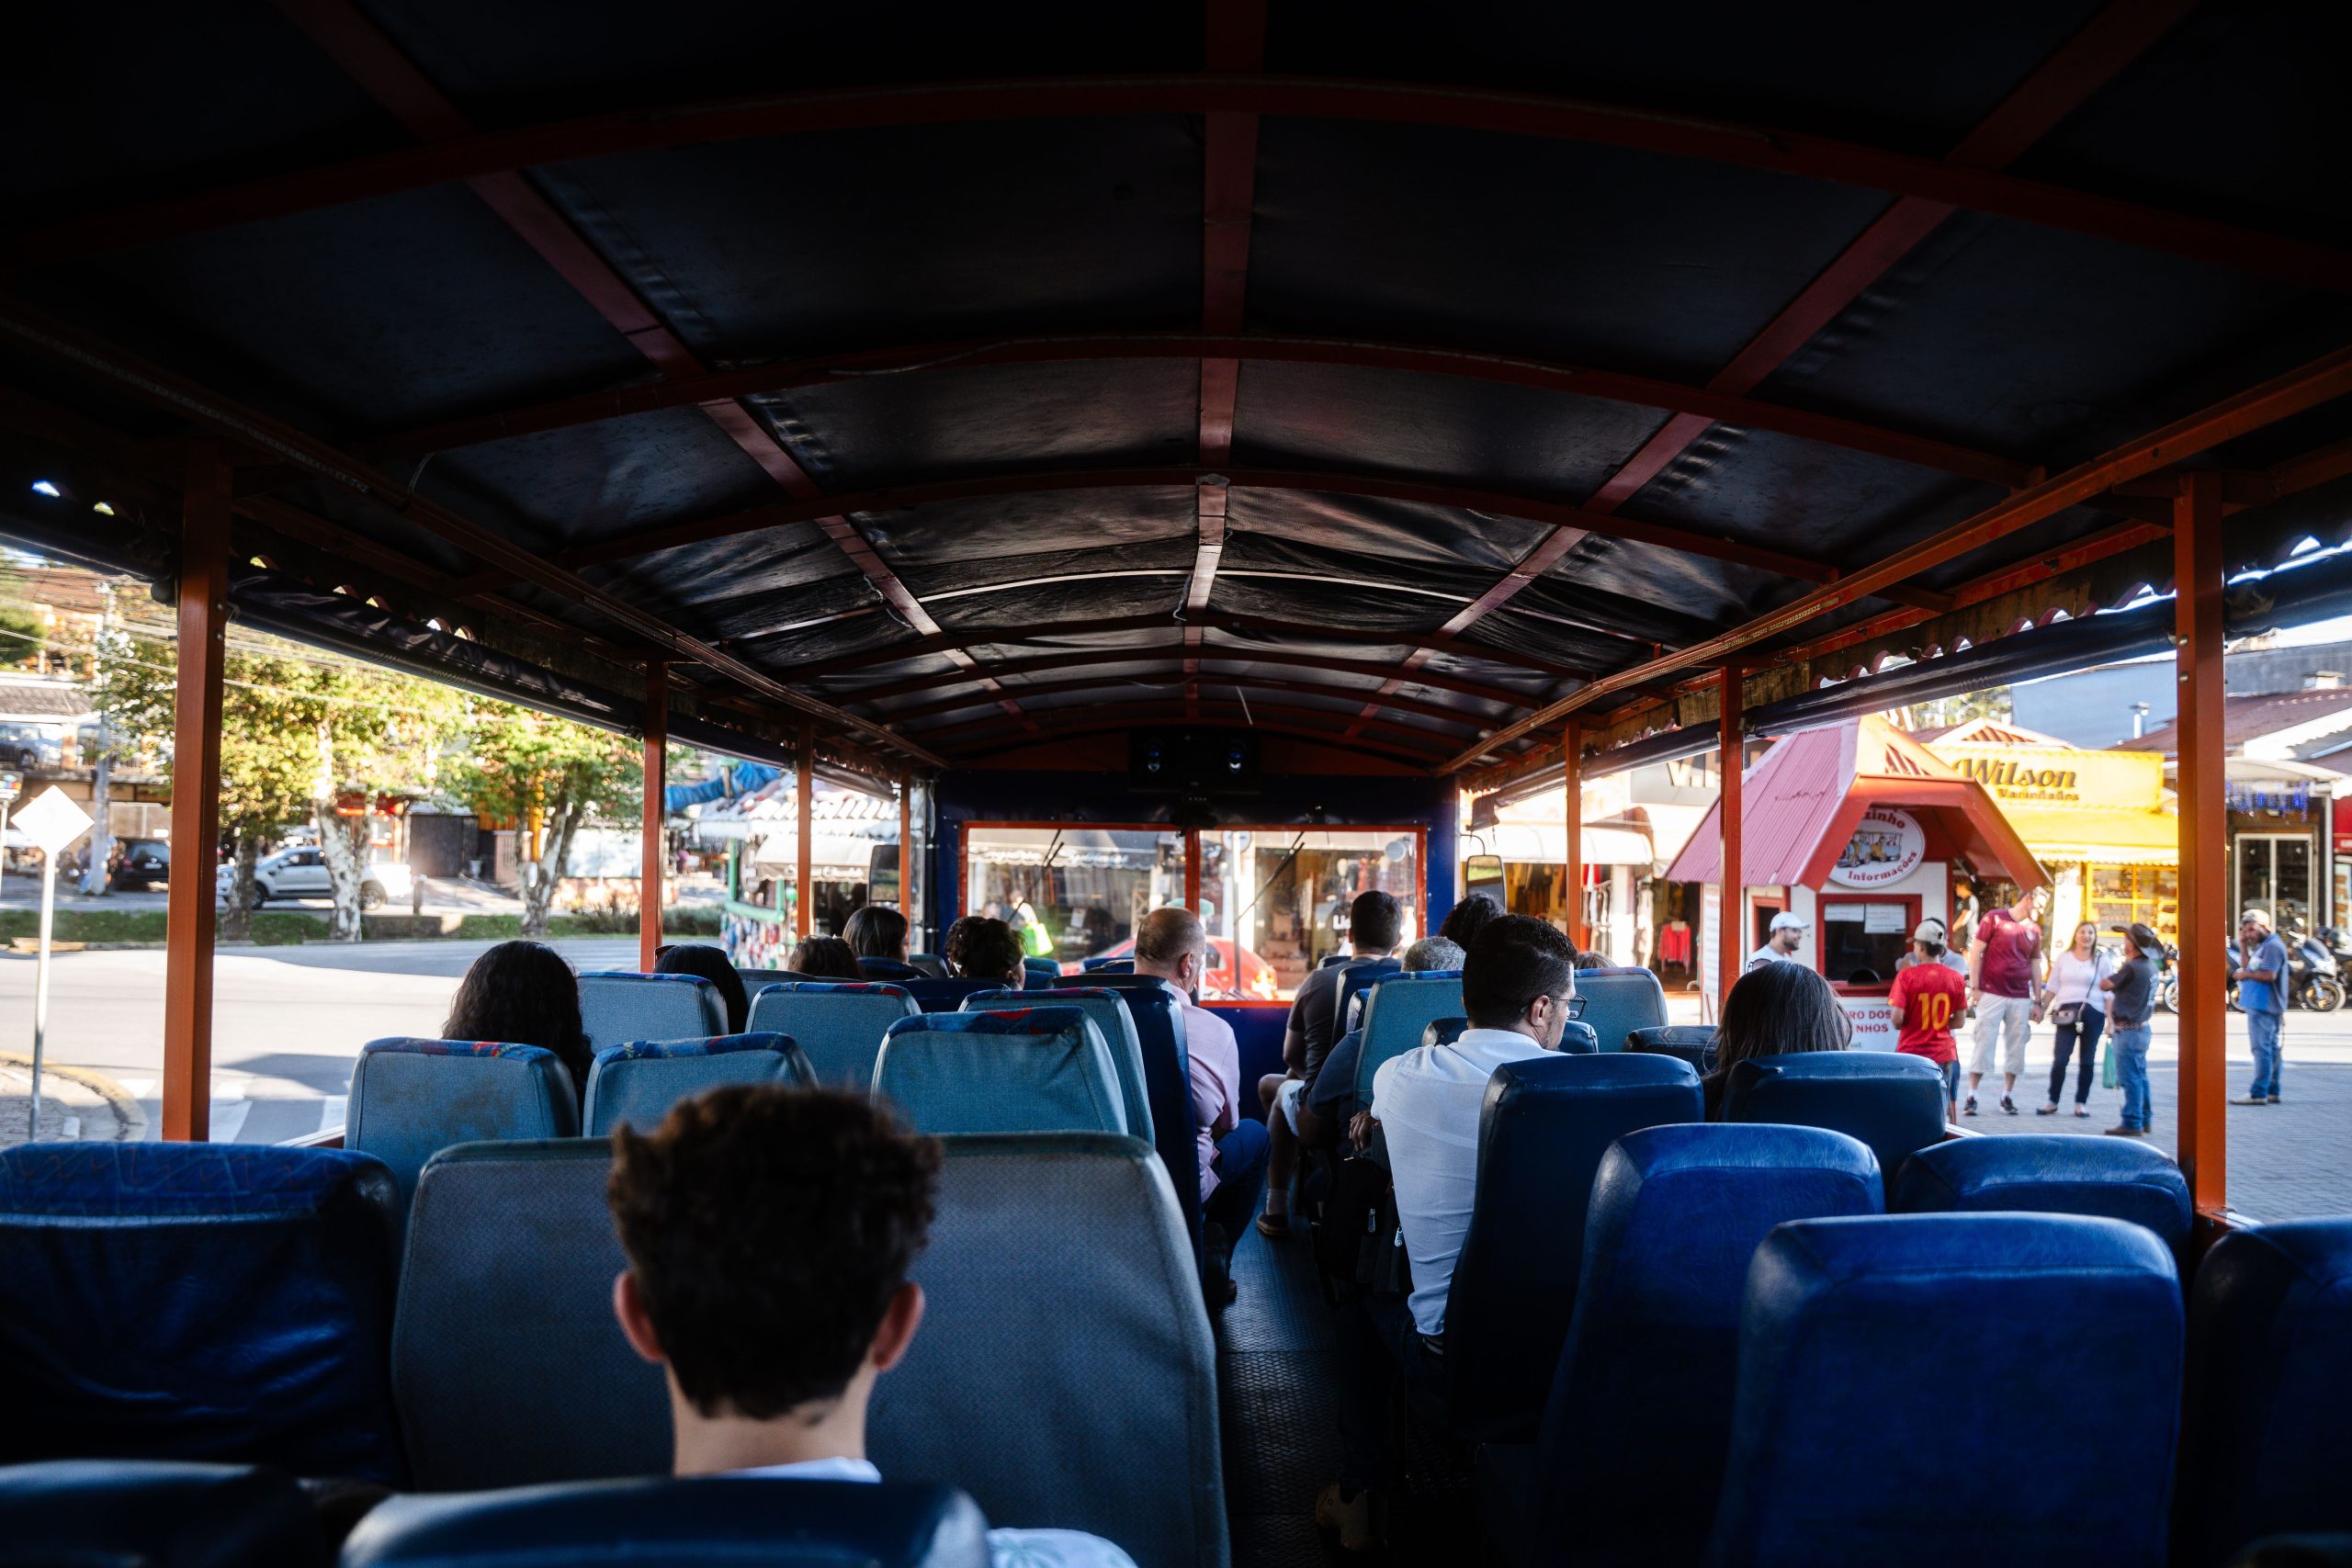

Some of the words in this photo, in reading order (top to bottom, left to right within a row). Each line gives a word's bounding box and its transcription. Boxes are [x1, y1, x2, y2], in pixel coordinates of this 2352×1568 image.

[1953, 758, 2076, 788] Wilson
[1848, 852, 1917, 881] Informações
[1869, 1010, 1891, 1020] DOS
[1917, 992, 1951, 1031] 10
